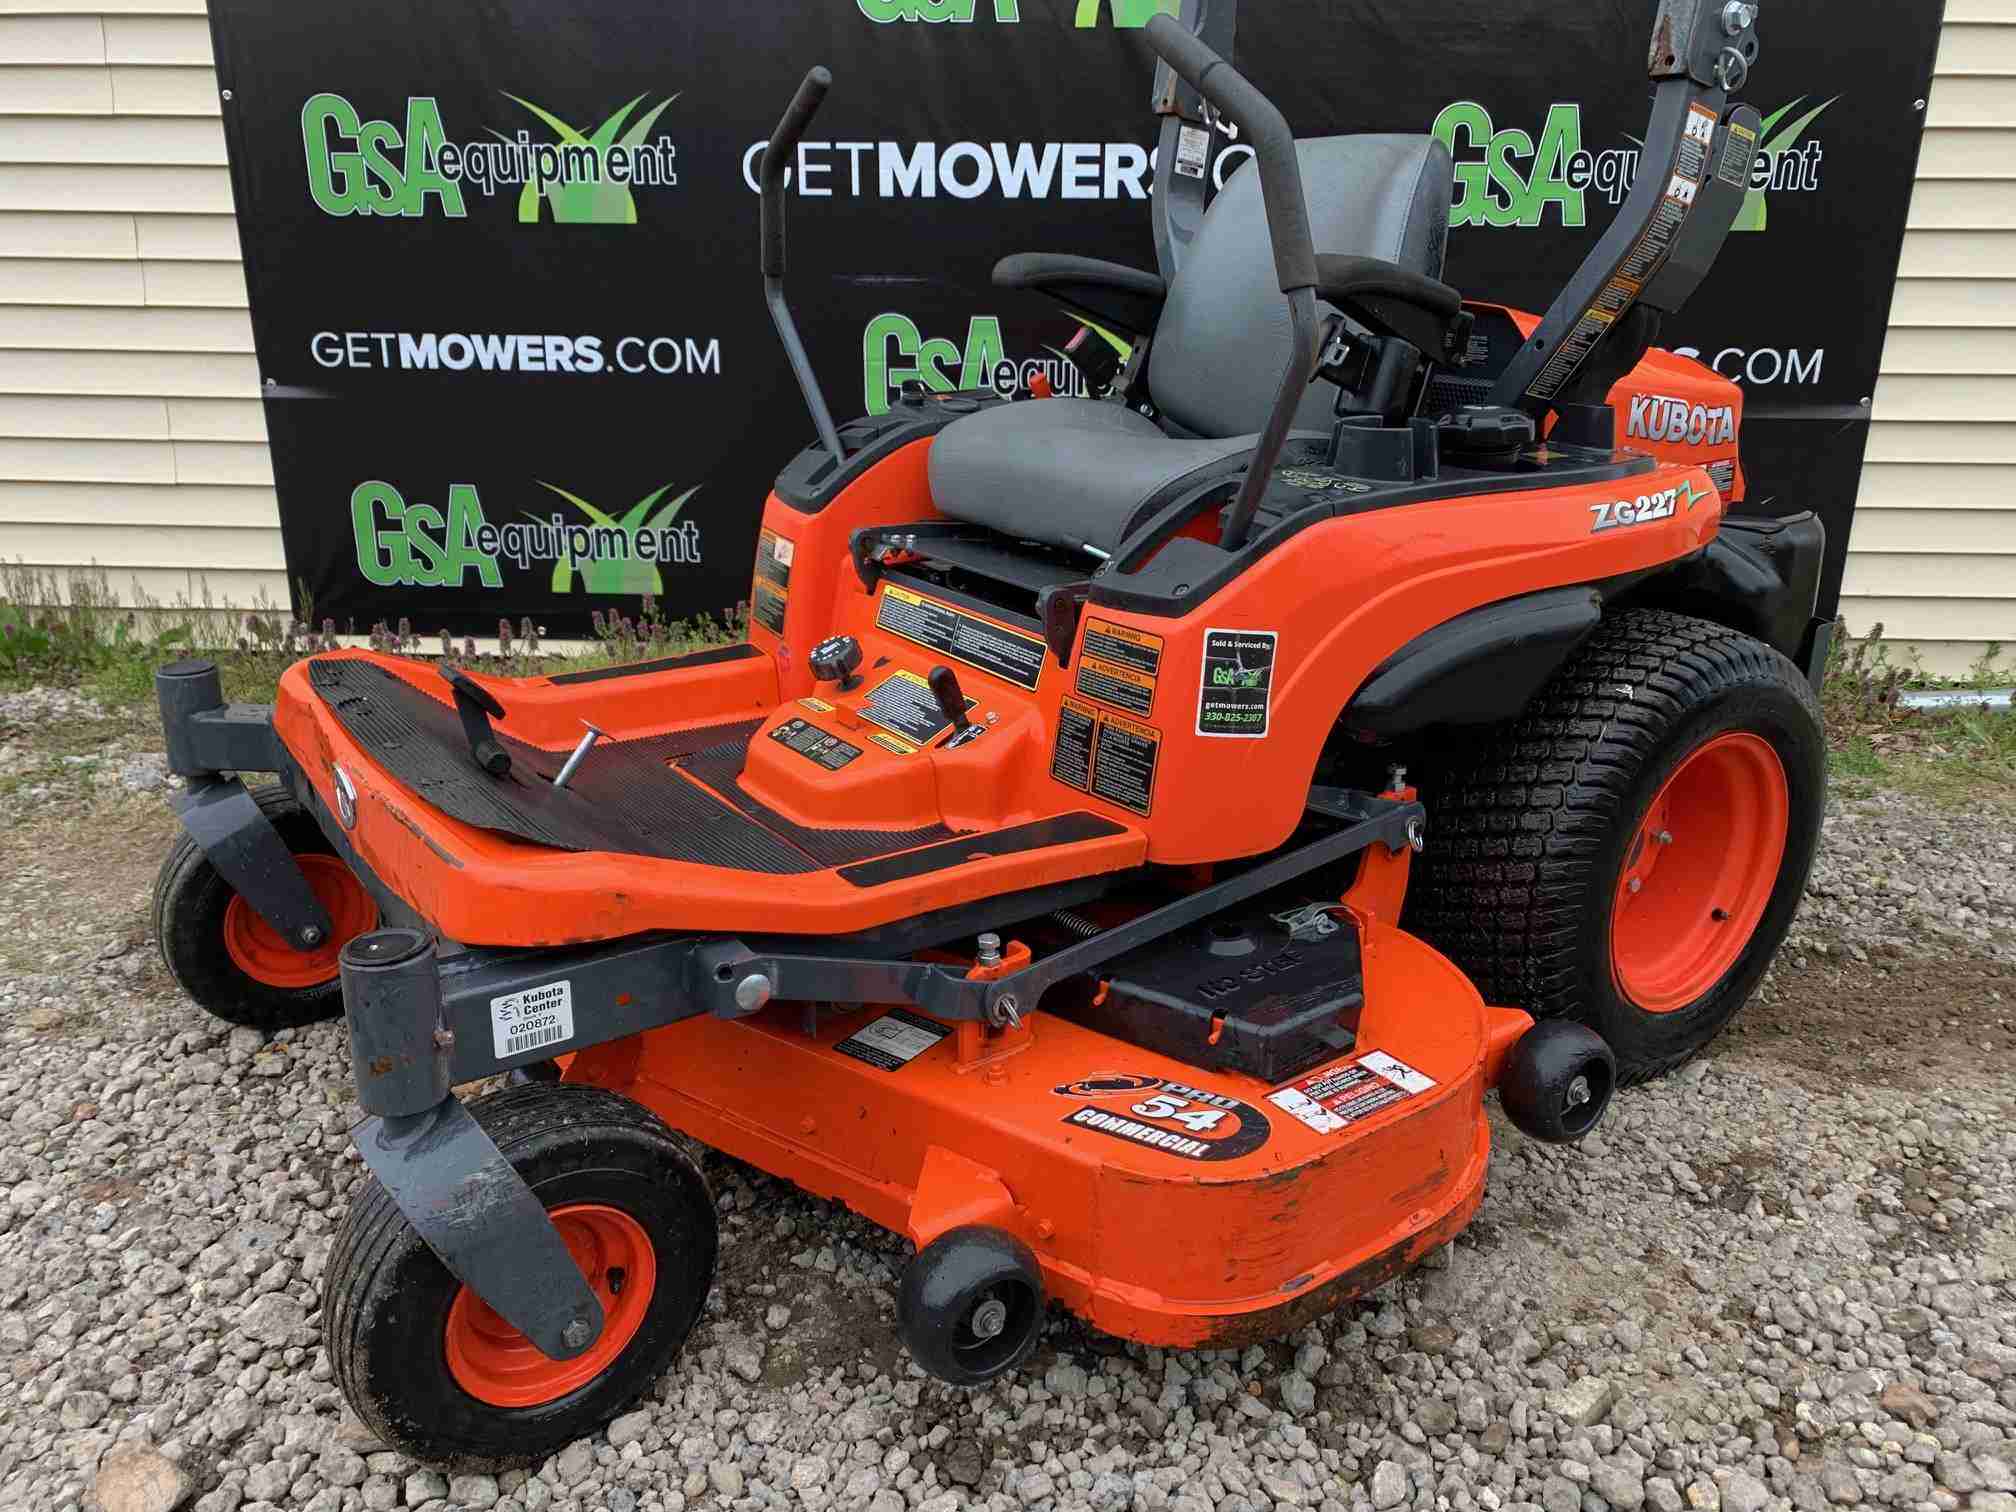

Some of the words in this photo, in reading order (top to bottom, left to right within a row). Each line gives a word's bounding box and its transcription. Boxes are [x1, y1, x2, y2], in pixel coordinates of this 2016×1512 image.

[311, 331, 720, 374] GETMOWERS.COM
[1627, 394, 1736, 446] KUBOTA
[1590, 489, 1677, 532] ZG227
[1211, 639, 1227, 648] Sold
[1233, 640, 1261, 649] Serviced
[1205, 702, 1265, 710] getmowers.com
[522, 987, 564, 1005] Kubota
[524, 998, 563, 1015] Center
[510, 1015, 556, 1035] 020872
[1160, 1081, 1240, 1110] PRO
[1130, 1094, 1228, 1132] 54
[1072, 1108, 1211, 1158] COMMERCIAL
